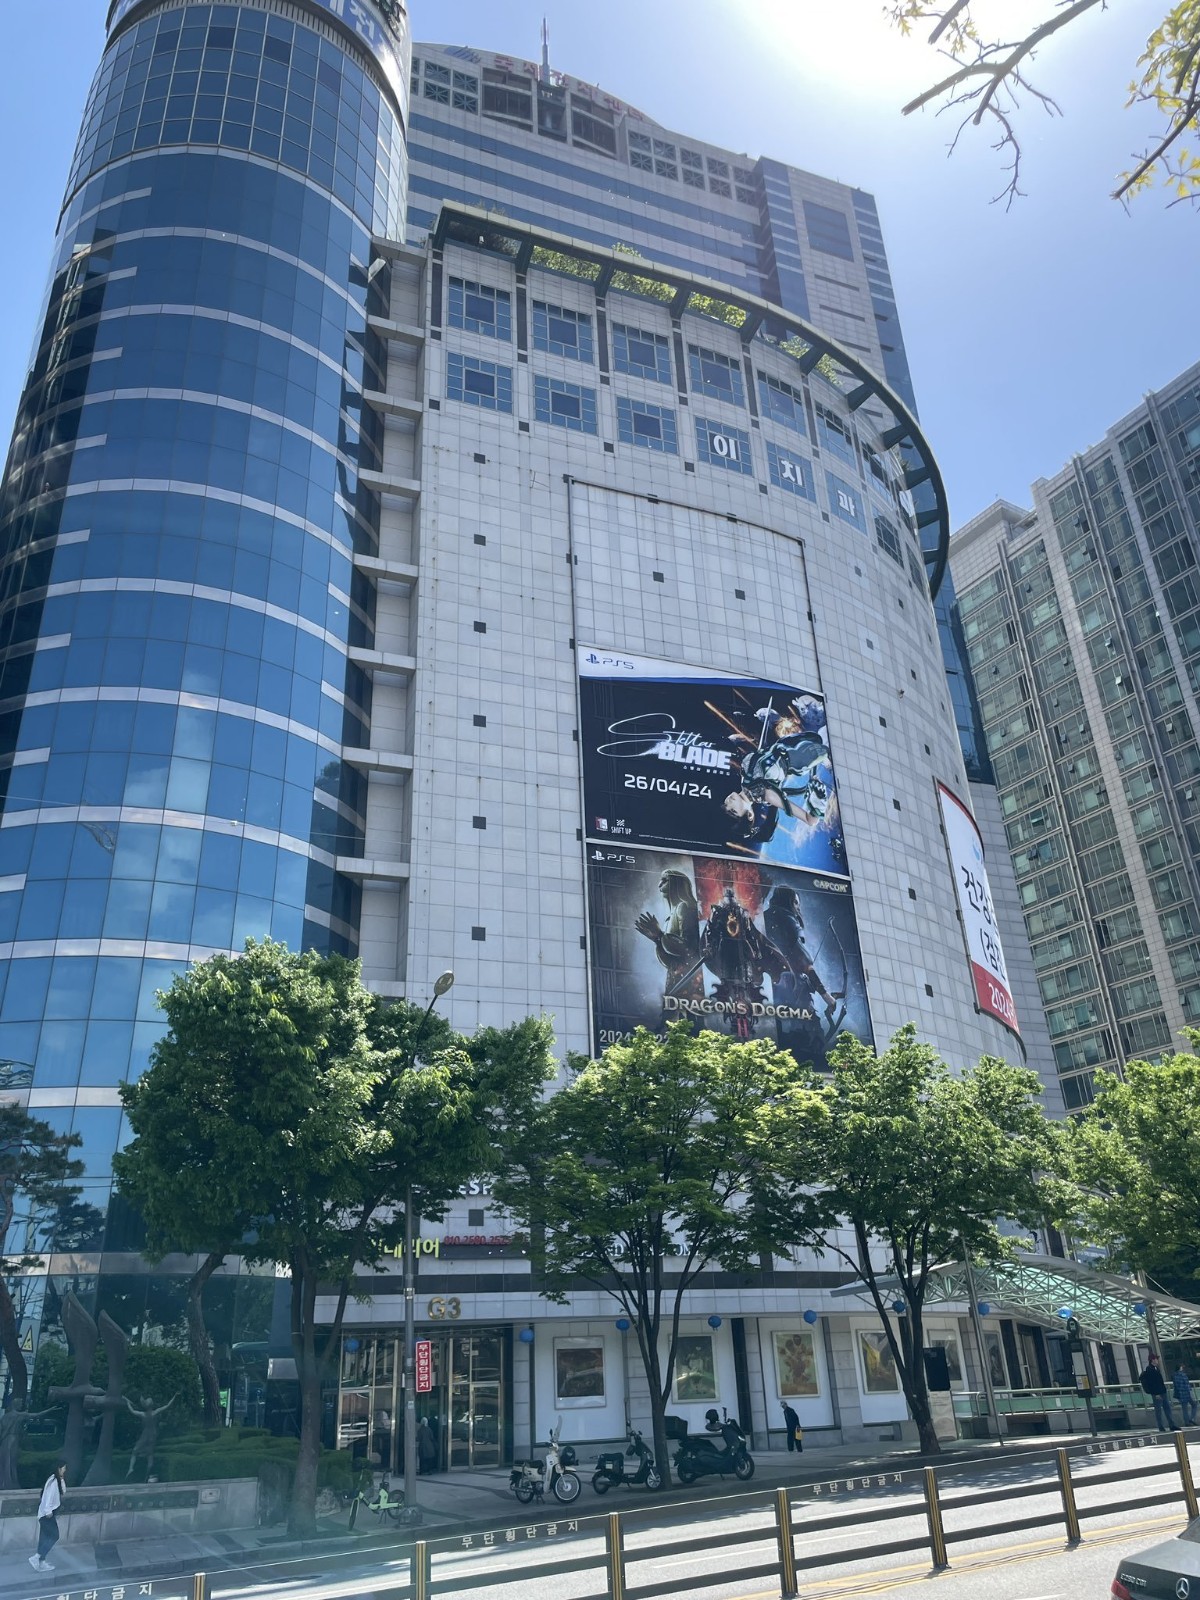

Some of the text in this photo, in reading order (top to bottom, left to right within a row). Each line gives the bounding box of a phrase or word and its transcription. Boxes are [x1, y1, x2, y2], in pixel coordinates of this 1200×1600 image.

[602, 656, 636, 671] PS5
[657, 741, 732, 770] BLADE
[624, 773, 713, 799] 26/04/24
[606, 853, 636, 864] PS5
[813, 879, 848, 893] CAPCOM
[662, 995, 812, 1021] DRAGON'S DOGMA
[427, 1297, 461, 1319] G3
[418, 1344, 429, 1388] 무단횡단금지
[813, 1473, 902, 1495] 무단횡단금지
[462, 1520, 578, 1548] 무단횡단금지
